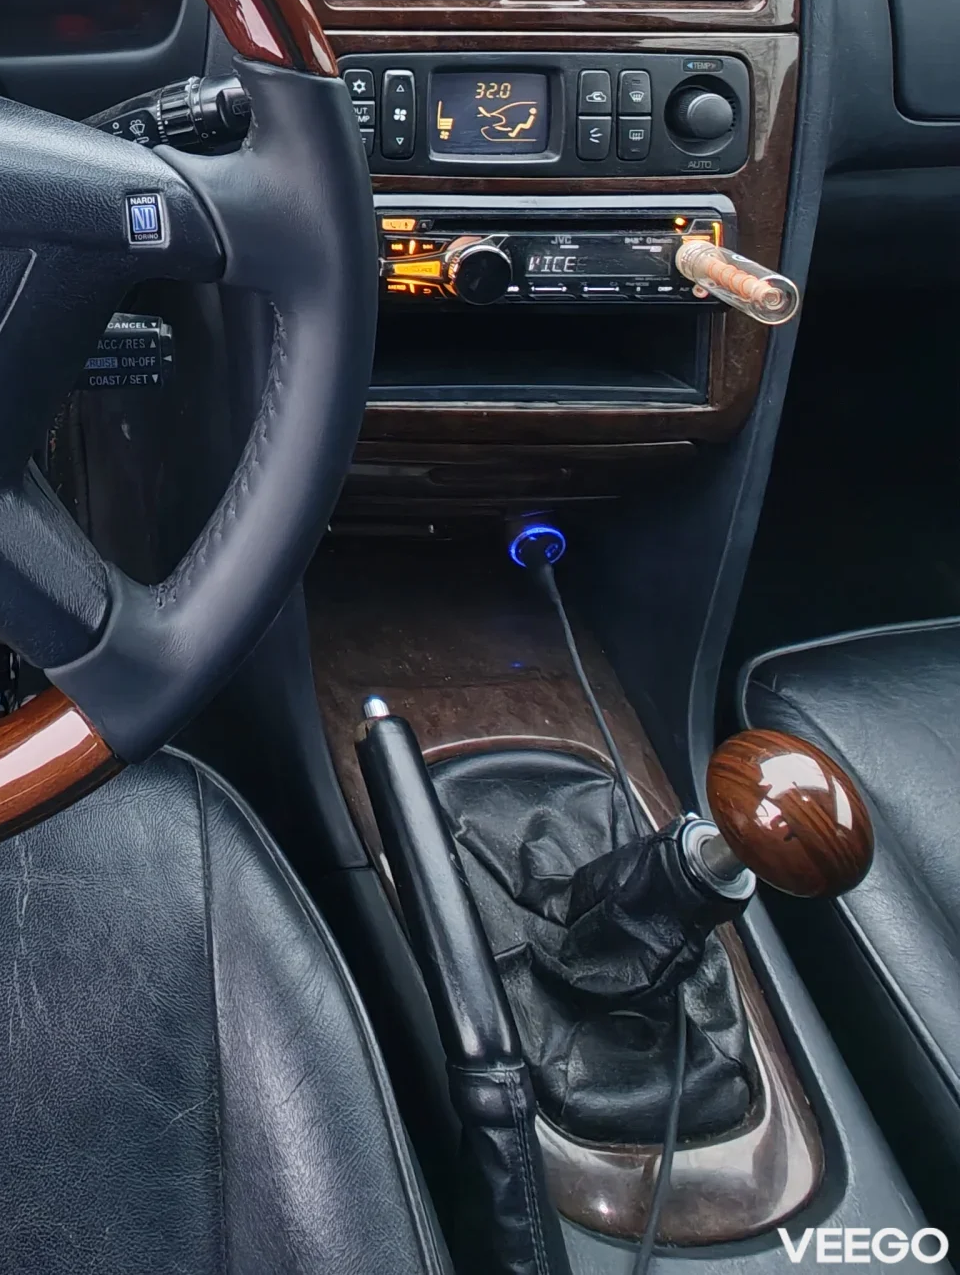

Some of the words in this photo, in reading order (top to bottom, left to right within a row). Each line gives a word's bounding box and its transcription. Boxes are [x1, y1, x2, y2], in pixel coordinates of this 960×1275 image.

[693, 61, 711, 70] TEMP
[475, 82, 511, 99] 32.0
[688, 160, 712, 168] AUTO
[130, 196, 156, 205] NARDI
[134, 233, 159, 241] TORINO
[550, 235, 572, 244] JVC
[87, 357, 118, 368] RUISE
[121, 356, 156, 367] ON-OFF
